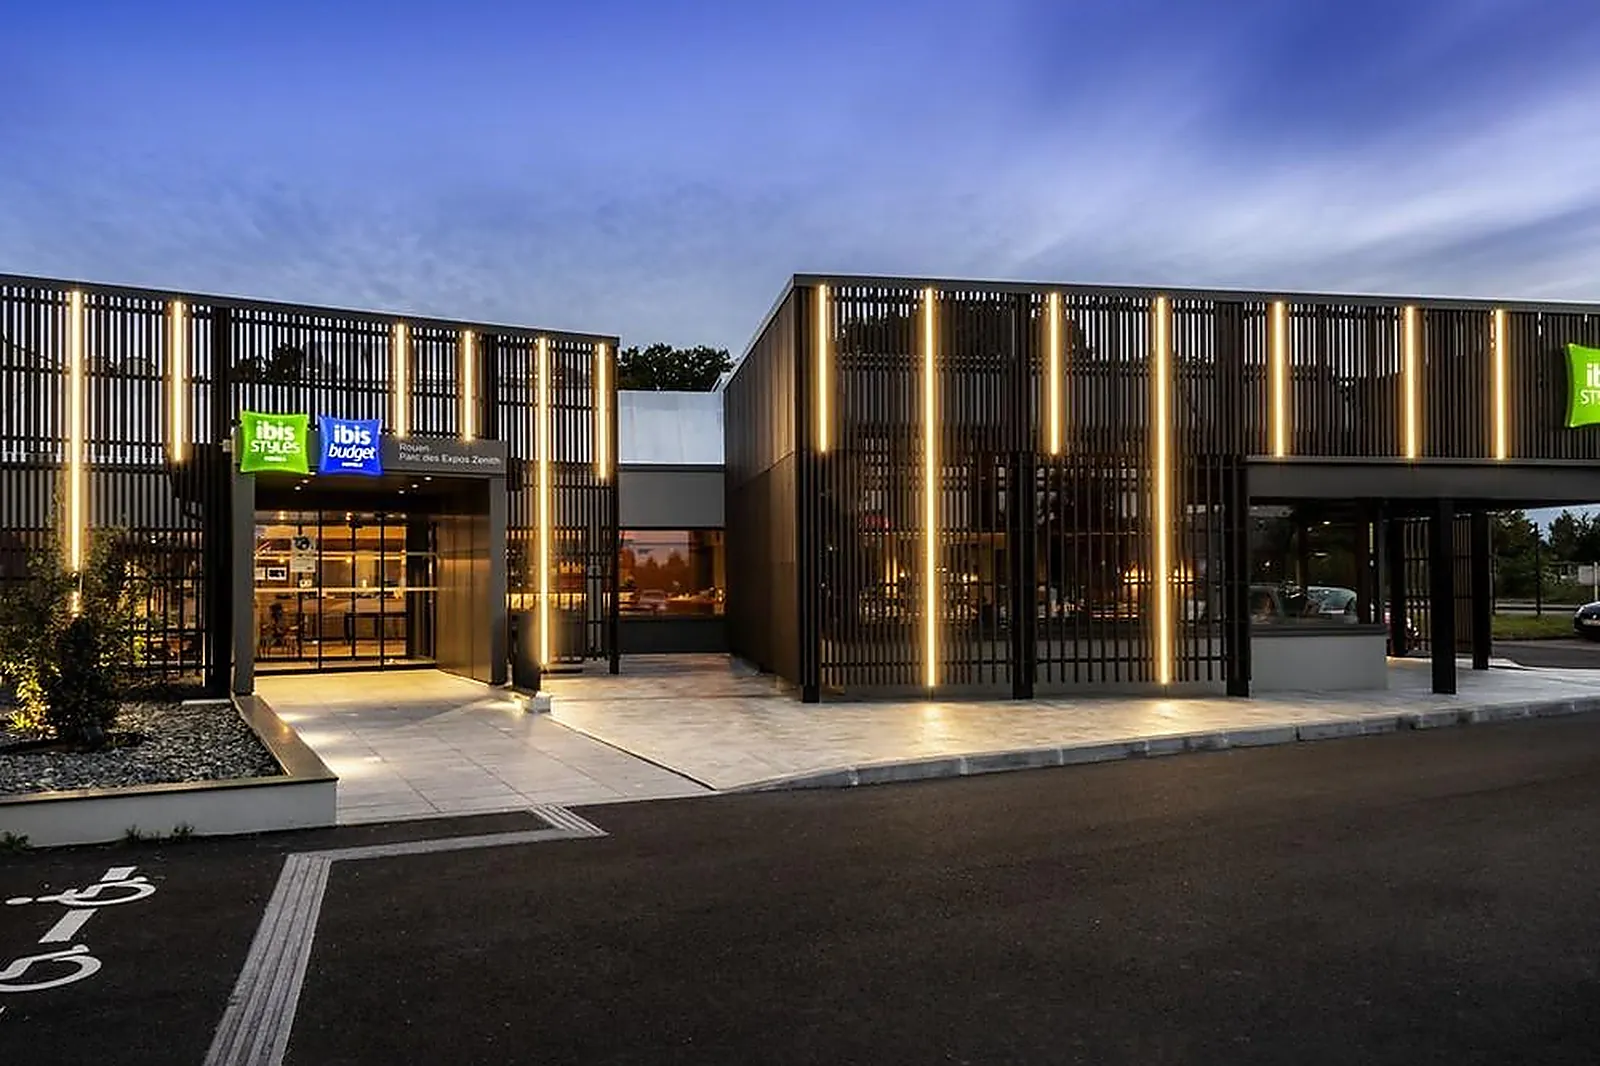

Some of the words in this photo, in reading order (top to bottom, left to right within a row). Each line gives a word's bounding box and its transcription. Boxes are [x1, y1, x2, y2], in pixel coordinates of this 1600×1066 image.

[256, 420, 295, 441] ibis
[333, 424, 372, 445] ibis
[328, 443, 375, 461] budget
[399, 443, 429, 453] Rouen
[399, 452, 420, 462] Parc
[422, 454, 440, 462] des
[442, 454, 471, 465] Expos
